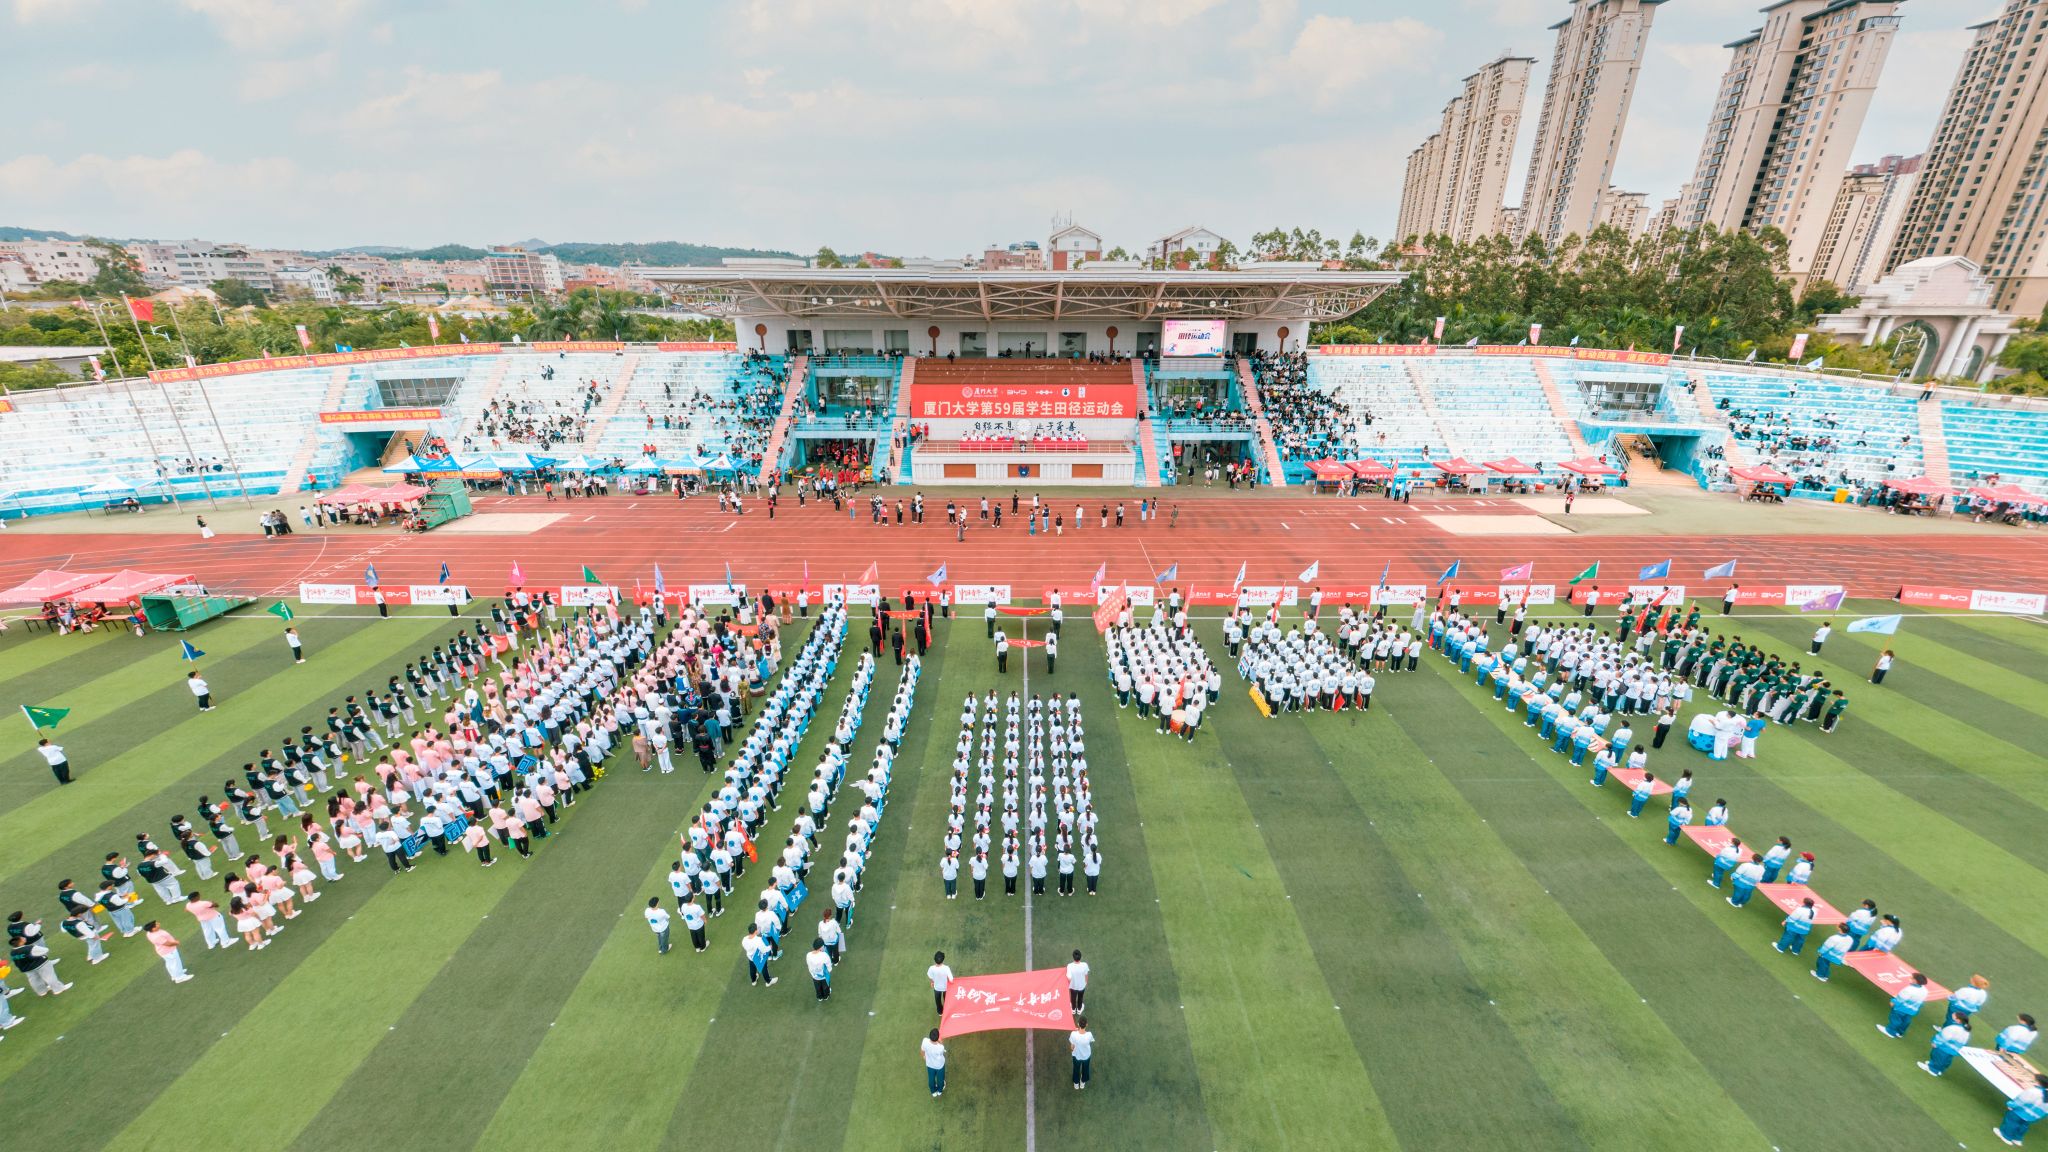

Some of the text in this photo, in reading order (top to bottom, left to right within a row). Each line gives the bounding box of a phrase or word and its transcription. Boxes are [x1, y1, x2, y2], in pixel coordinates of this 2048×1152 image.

[1325, 346, 1432, 354] 与时俱进建设世界一流大学
[923, 401, 1124, 416] 厦门大学第59届学生田径运动会
[1939, 593, 1968, 601] BYD
